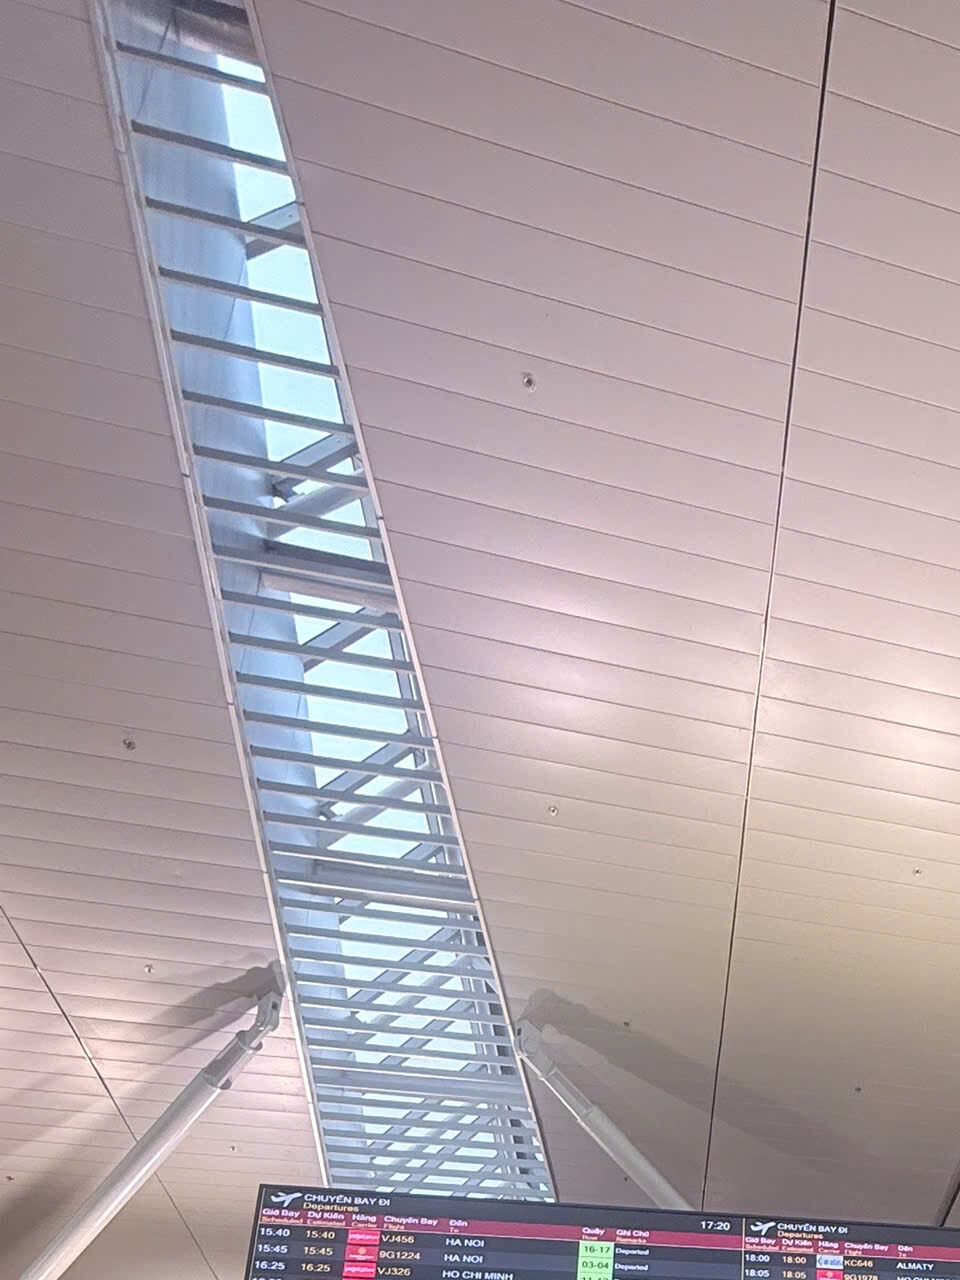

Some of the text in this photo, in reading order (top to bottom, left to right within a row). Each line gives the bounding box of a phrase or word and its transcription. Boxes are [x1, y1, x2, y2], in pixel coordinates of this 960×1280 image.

[354, 1196, 376, 1205] BAY
[303, 1202, 359, 1212] Departures
[700, 1221, 730, 1231] 17:20
[818, 1225, 836, 1233] BAY
[260, 1228, 290, 1236] 15:40
[306, 1231, 335, 1239] 15:40
[446, 1238, 462, 1246] HA
[464, 1239, 484, 1247] NOI
[258, 1244, 288, 1253] 15:45
[304, 1247, 333, 1255] 15:45
[380, 1251, 420, 1260] 9G1224
[444, 1254, 460, 1262] HA
[463, 1255, 483, 1263] NOI
[745, 1254, 934, 1270] 18:00 ALMATY
[255, 1261, 285, 1270] 16:25
[302, 1264, 331, 1272] 16:25
[442, 1270, 460, 1278] HO
[462, 1271, 481, 1279] CHI
[484, 1272, 513, 1280] MINH
[745, 1269, 770, 1277] 18:05
